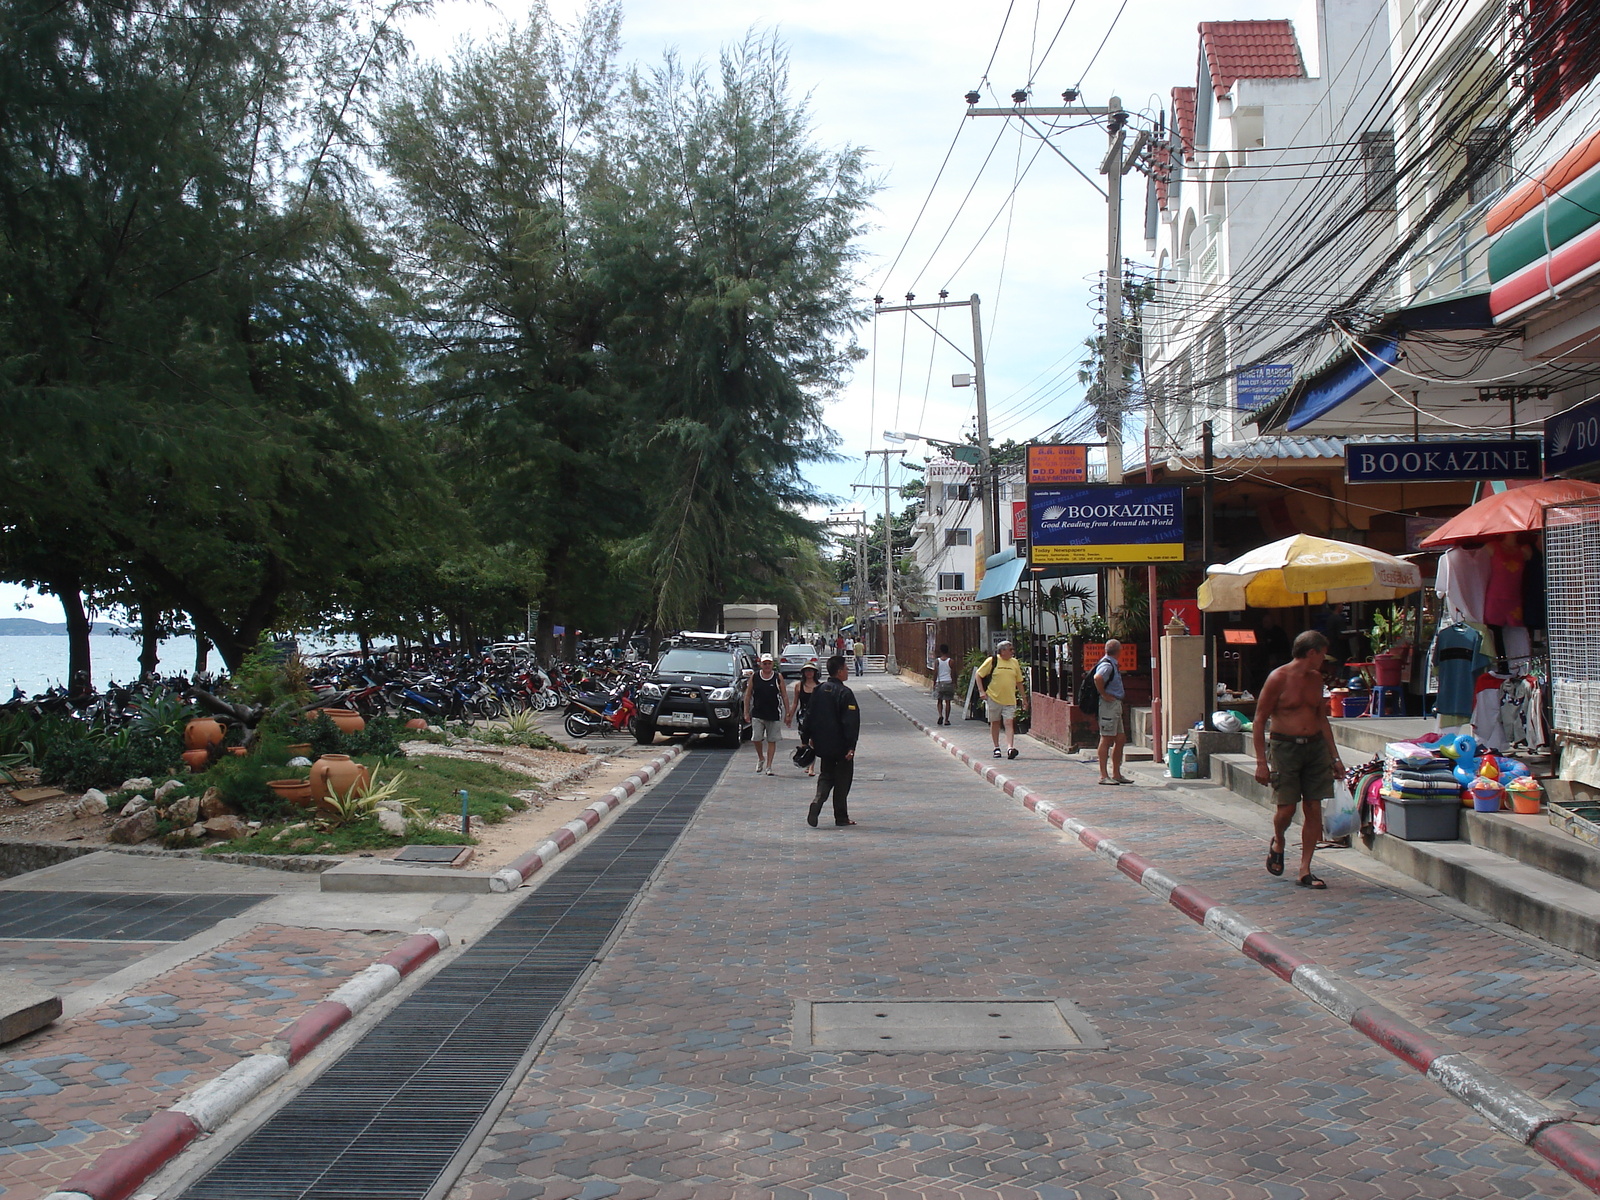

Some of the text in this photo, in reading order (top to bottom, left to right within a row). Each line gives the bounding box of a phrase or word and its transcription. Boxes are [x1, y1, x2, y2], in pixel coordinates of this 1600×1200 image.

[1361, 450, 1530, 474] BOOKAZINE
[1114, 489, 1133, 498] Sun
[1068, 503, 1174, 518] BOOKAZINE
[1062, 520, 1090, 529] Reading
[1091, 520, 1109, 529] from
